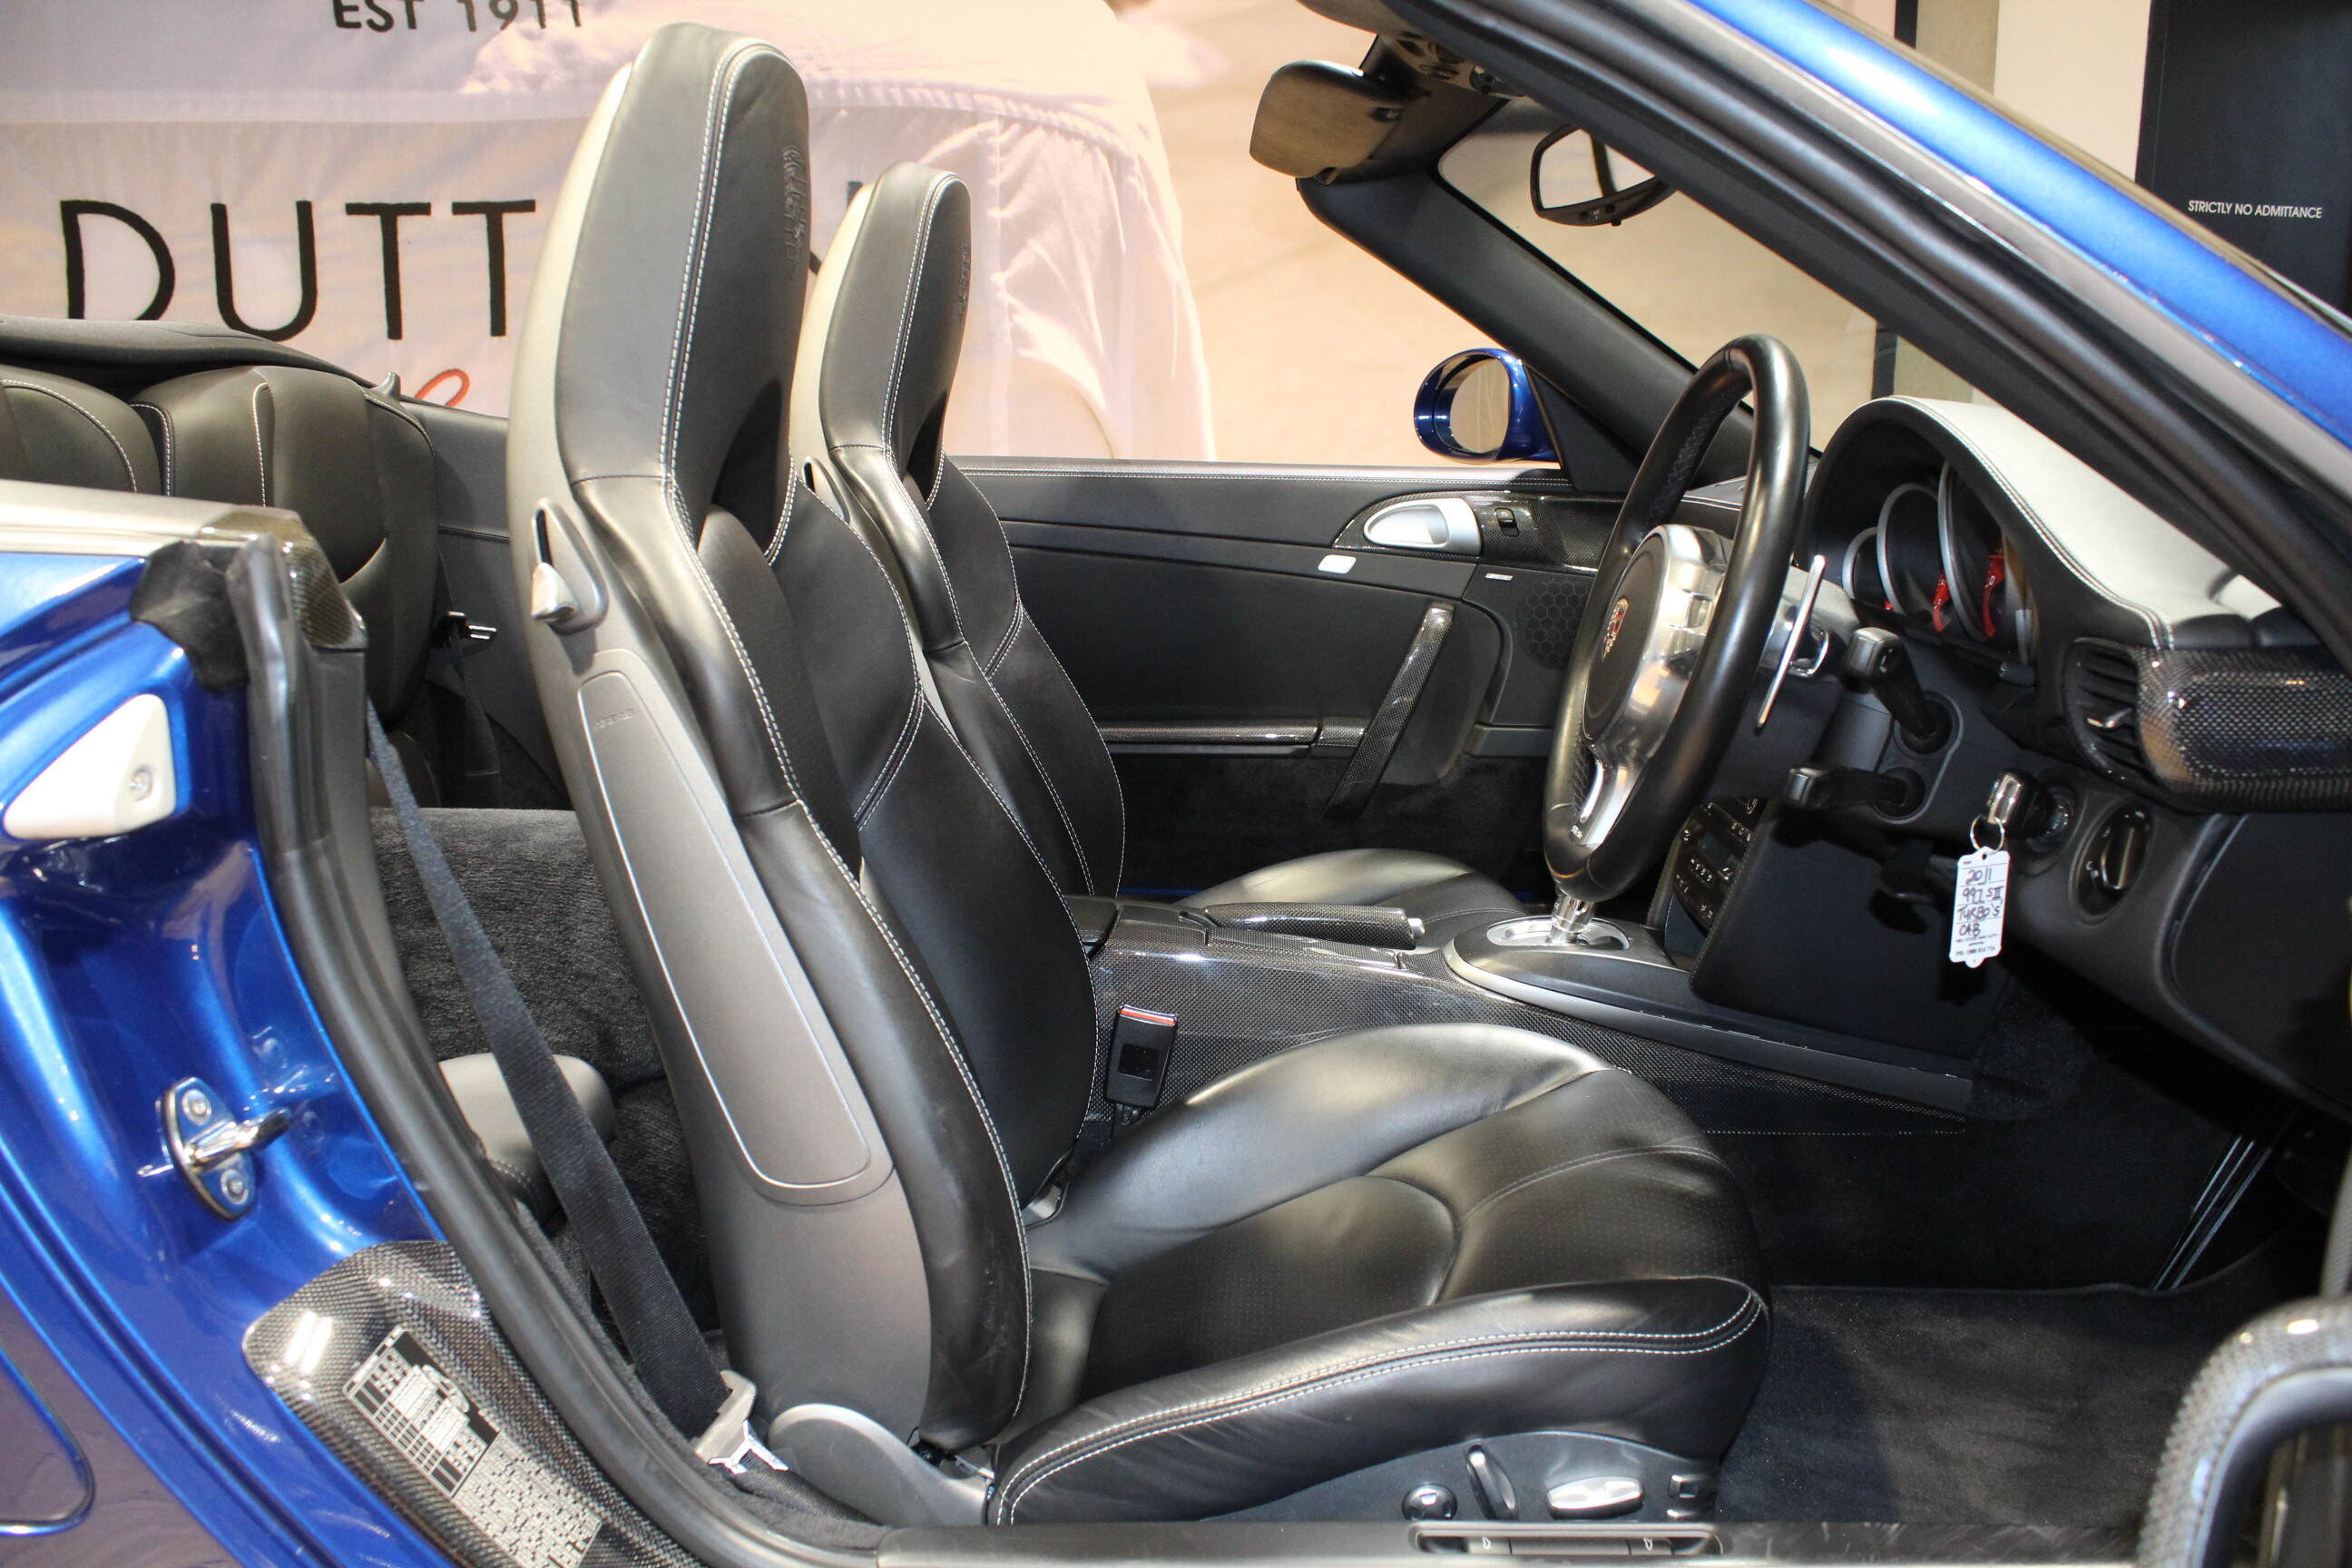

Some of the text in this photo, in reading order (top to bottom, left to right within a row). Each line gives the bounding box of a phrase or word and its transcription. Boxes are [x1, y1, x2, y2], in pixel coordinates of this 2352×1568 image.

[333, 0, 582, 33] EST 1911
[2188, 200, 2323, 219] STRICTLY NO ADMITTANCE
[60, 200, 537, 341] DUTT
[1965, 867, 1993, 886] 2011
[1962, 888, 1984, 904] 997
